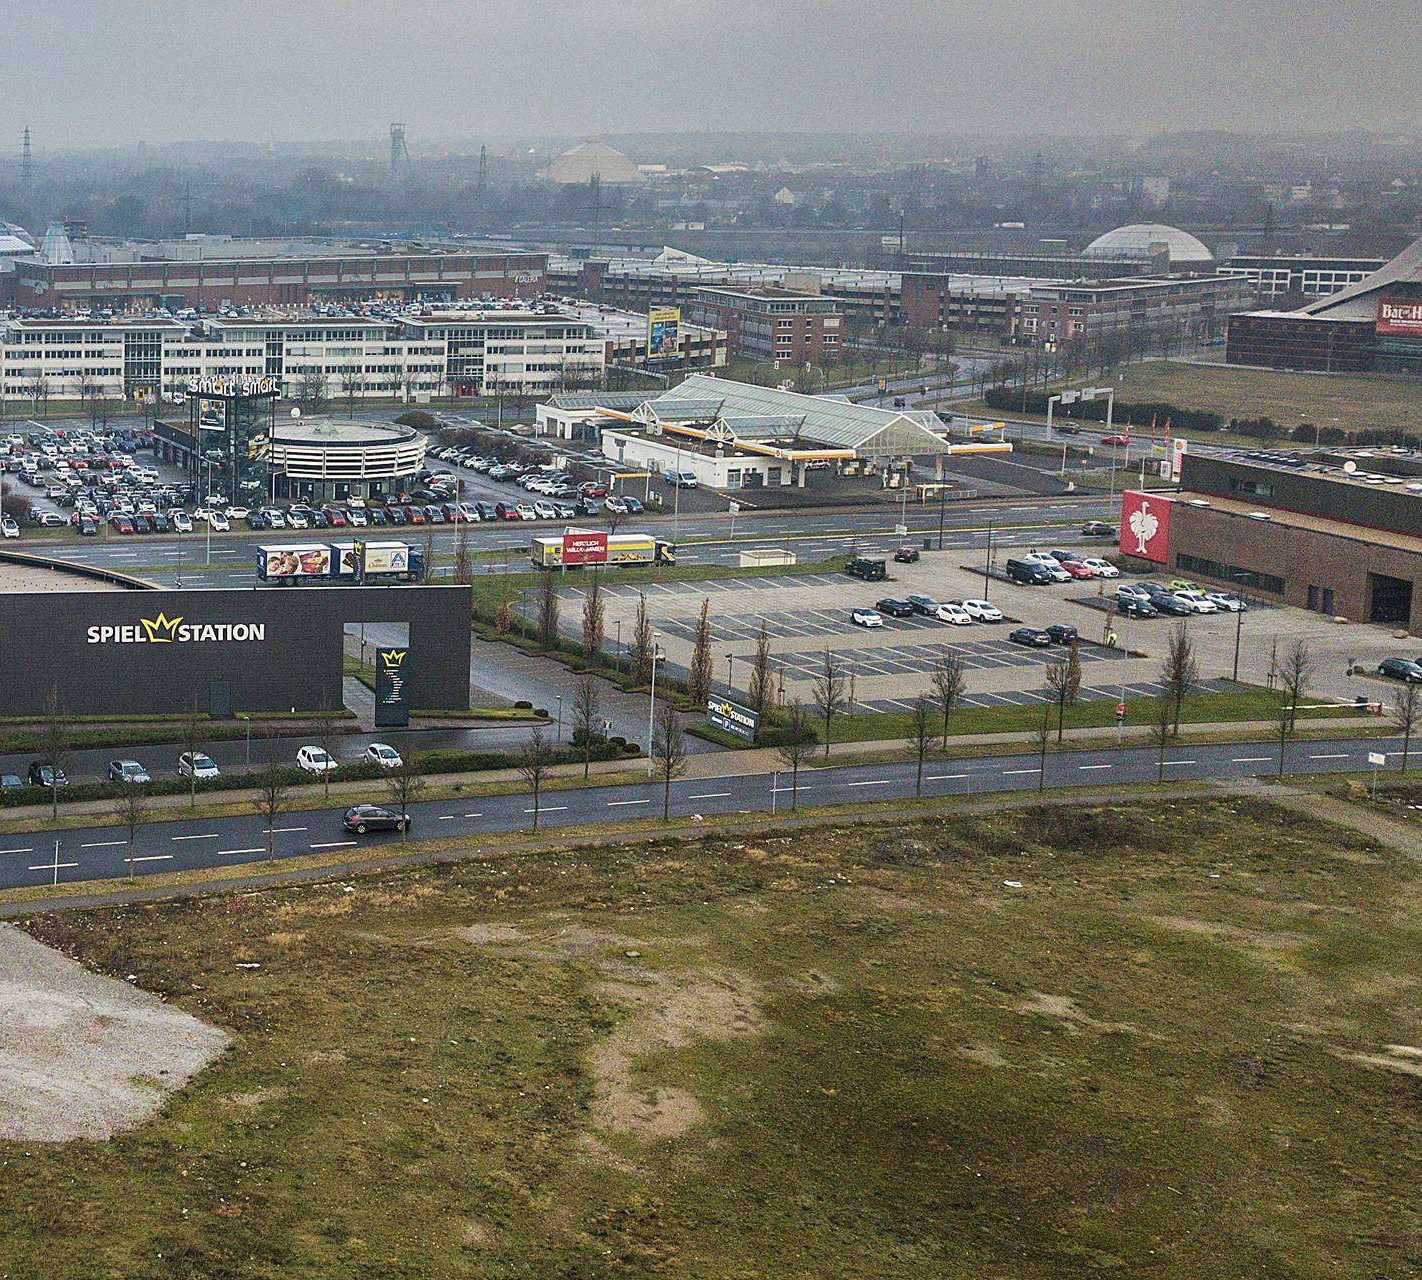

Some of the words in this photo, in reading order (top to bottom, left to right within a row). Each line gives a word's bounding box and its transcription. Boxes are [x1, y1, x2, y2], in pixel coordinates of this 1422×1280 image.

[189, 377, 236, 397] smart
[242, 377, 280, 397] smart
[87, 626, 146, 644] SPIEL
[178, 624, 265, 642] STATION
[708, 700, 725, 716] SPIEL
[730, 710, 755, 728] STATION
